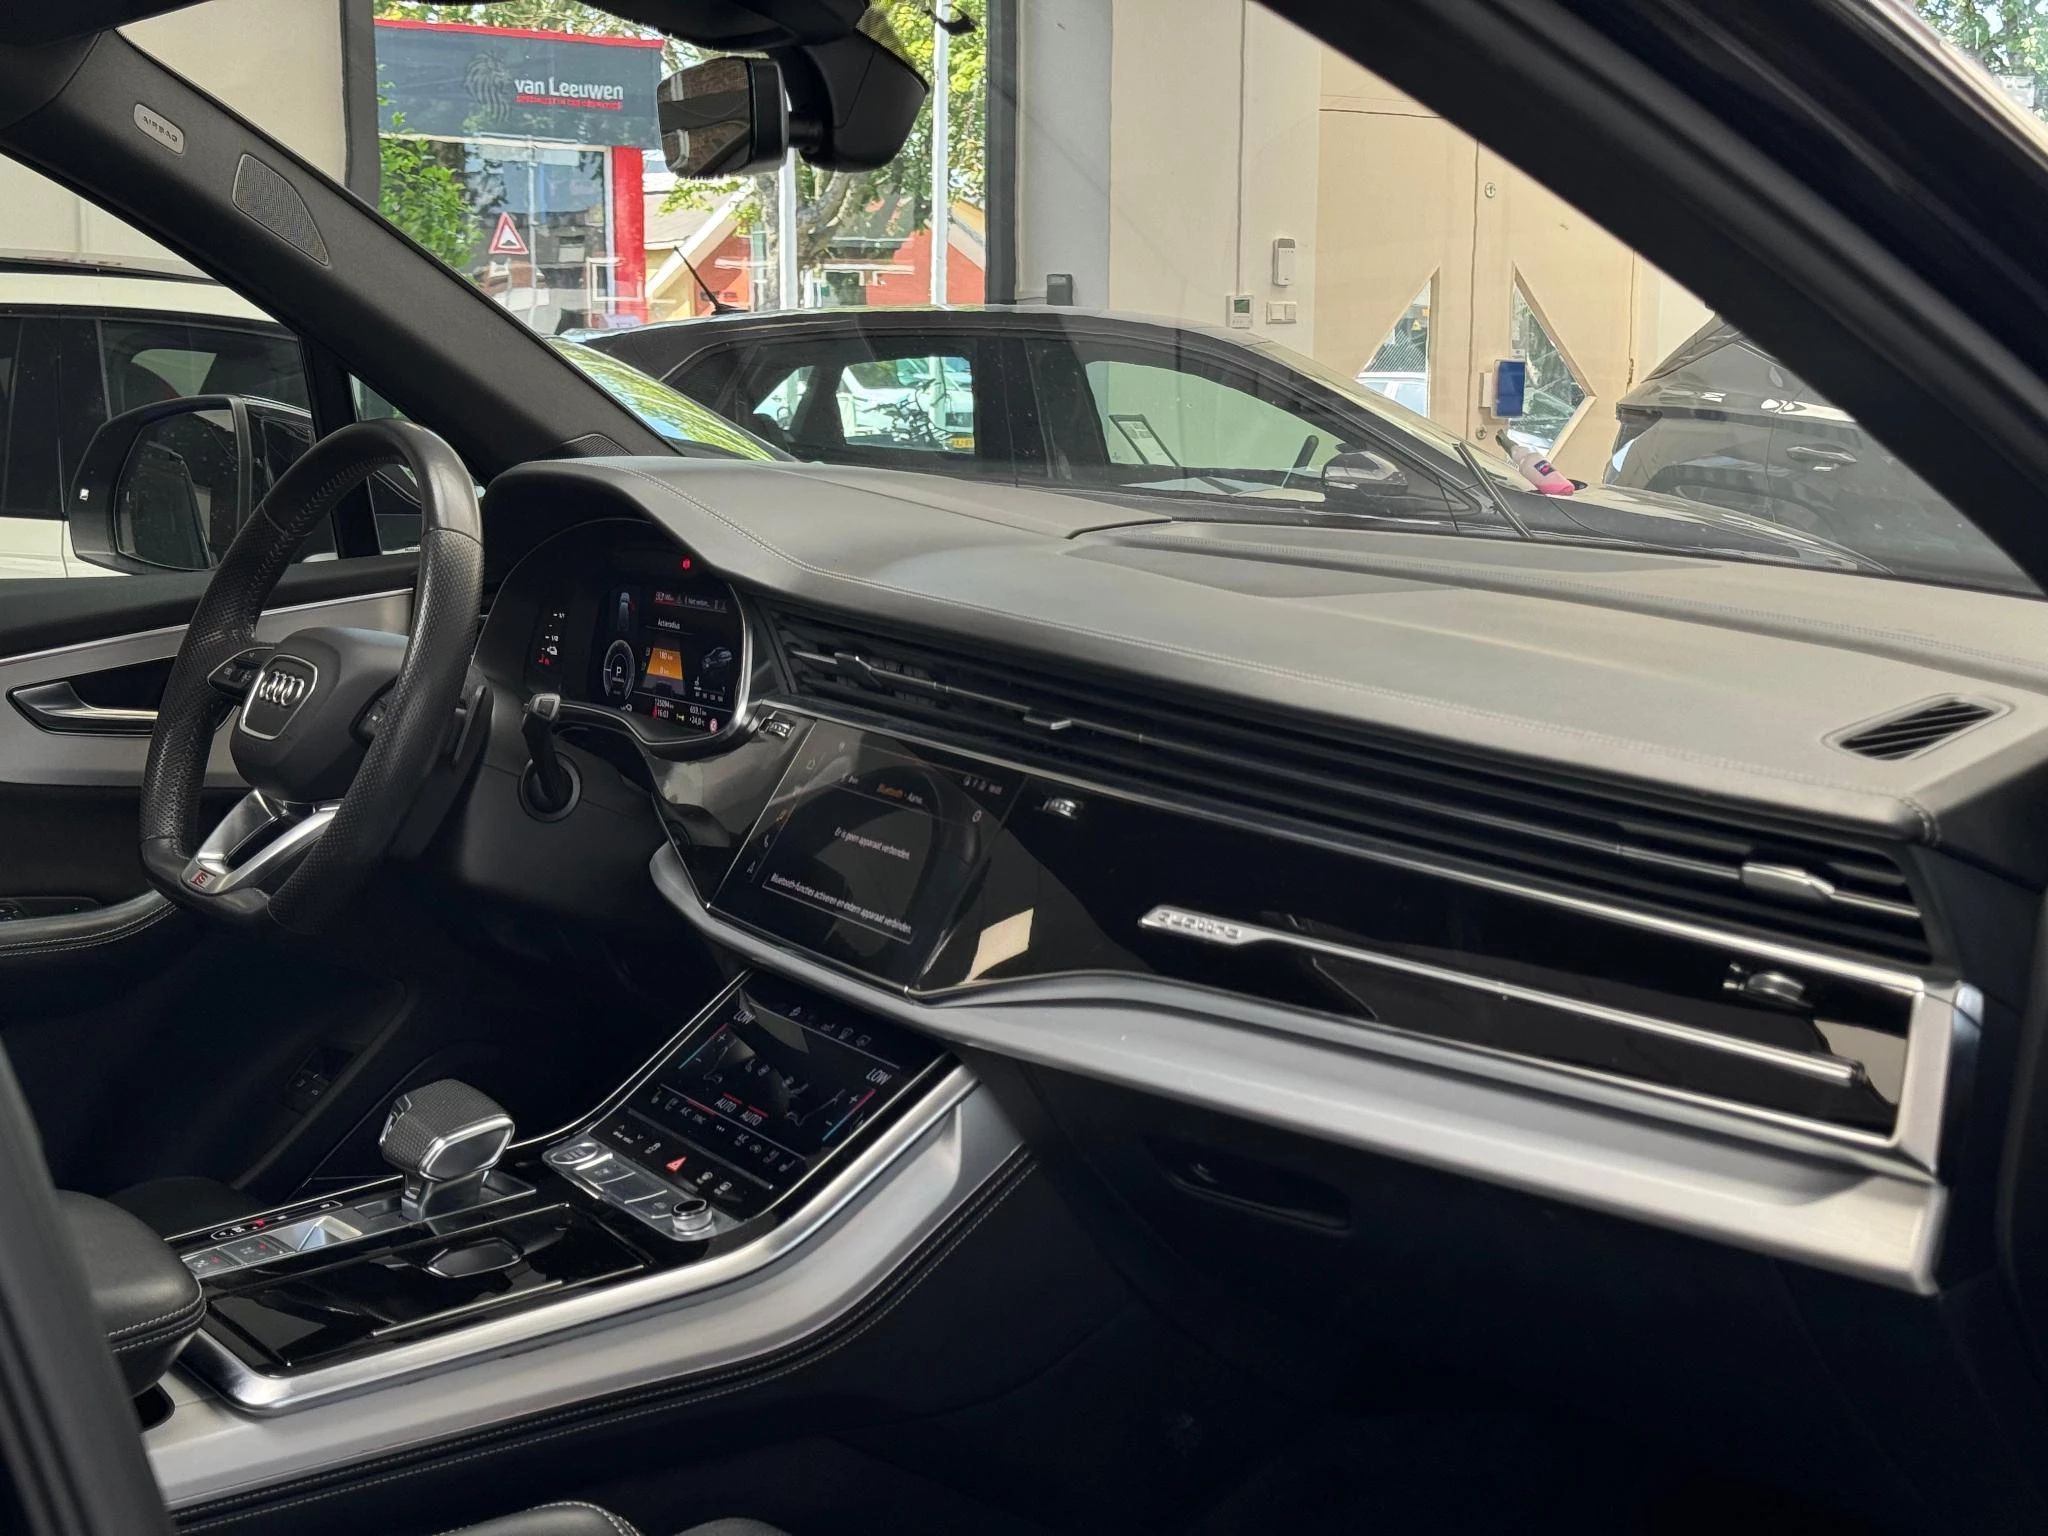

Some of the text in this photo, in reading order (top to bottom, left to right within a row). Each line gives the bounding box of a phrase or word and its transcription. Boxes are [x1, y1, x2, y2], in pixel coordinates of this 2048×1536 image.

[514, 76, 624, 100] van Leeuwen
[143, 115, 178, 143] AIRBAG
[616, 666, 622, 677] P
[733, 1010, 756, 1025] LOW
[865, 1067, 893, 1086] LOW
[714, 1098, 737, 1113] AUTO
[739, 1110, 763, 1126] AUTO
